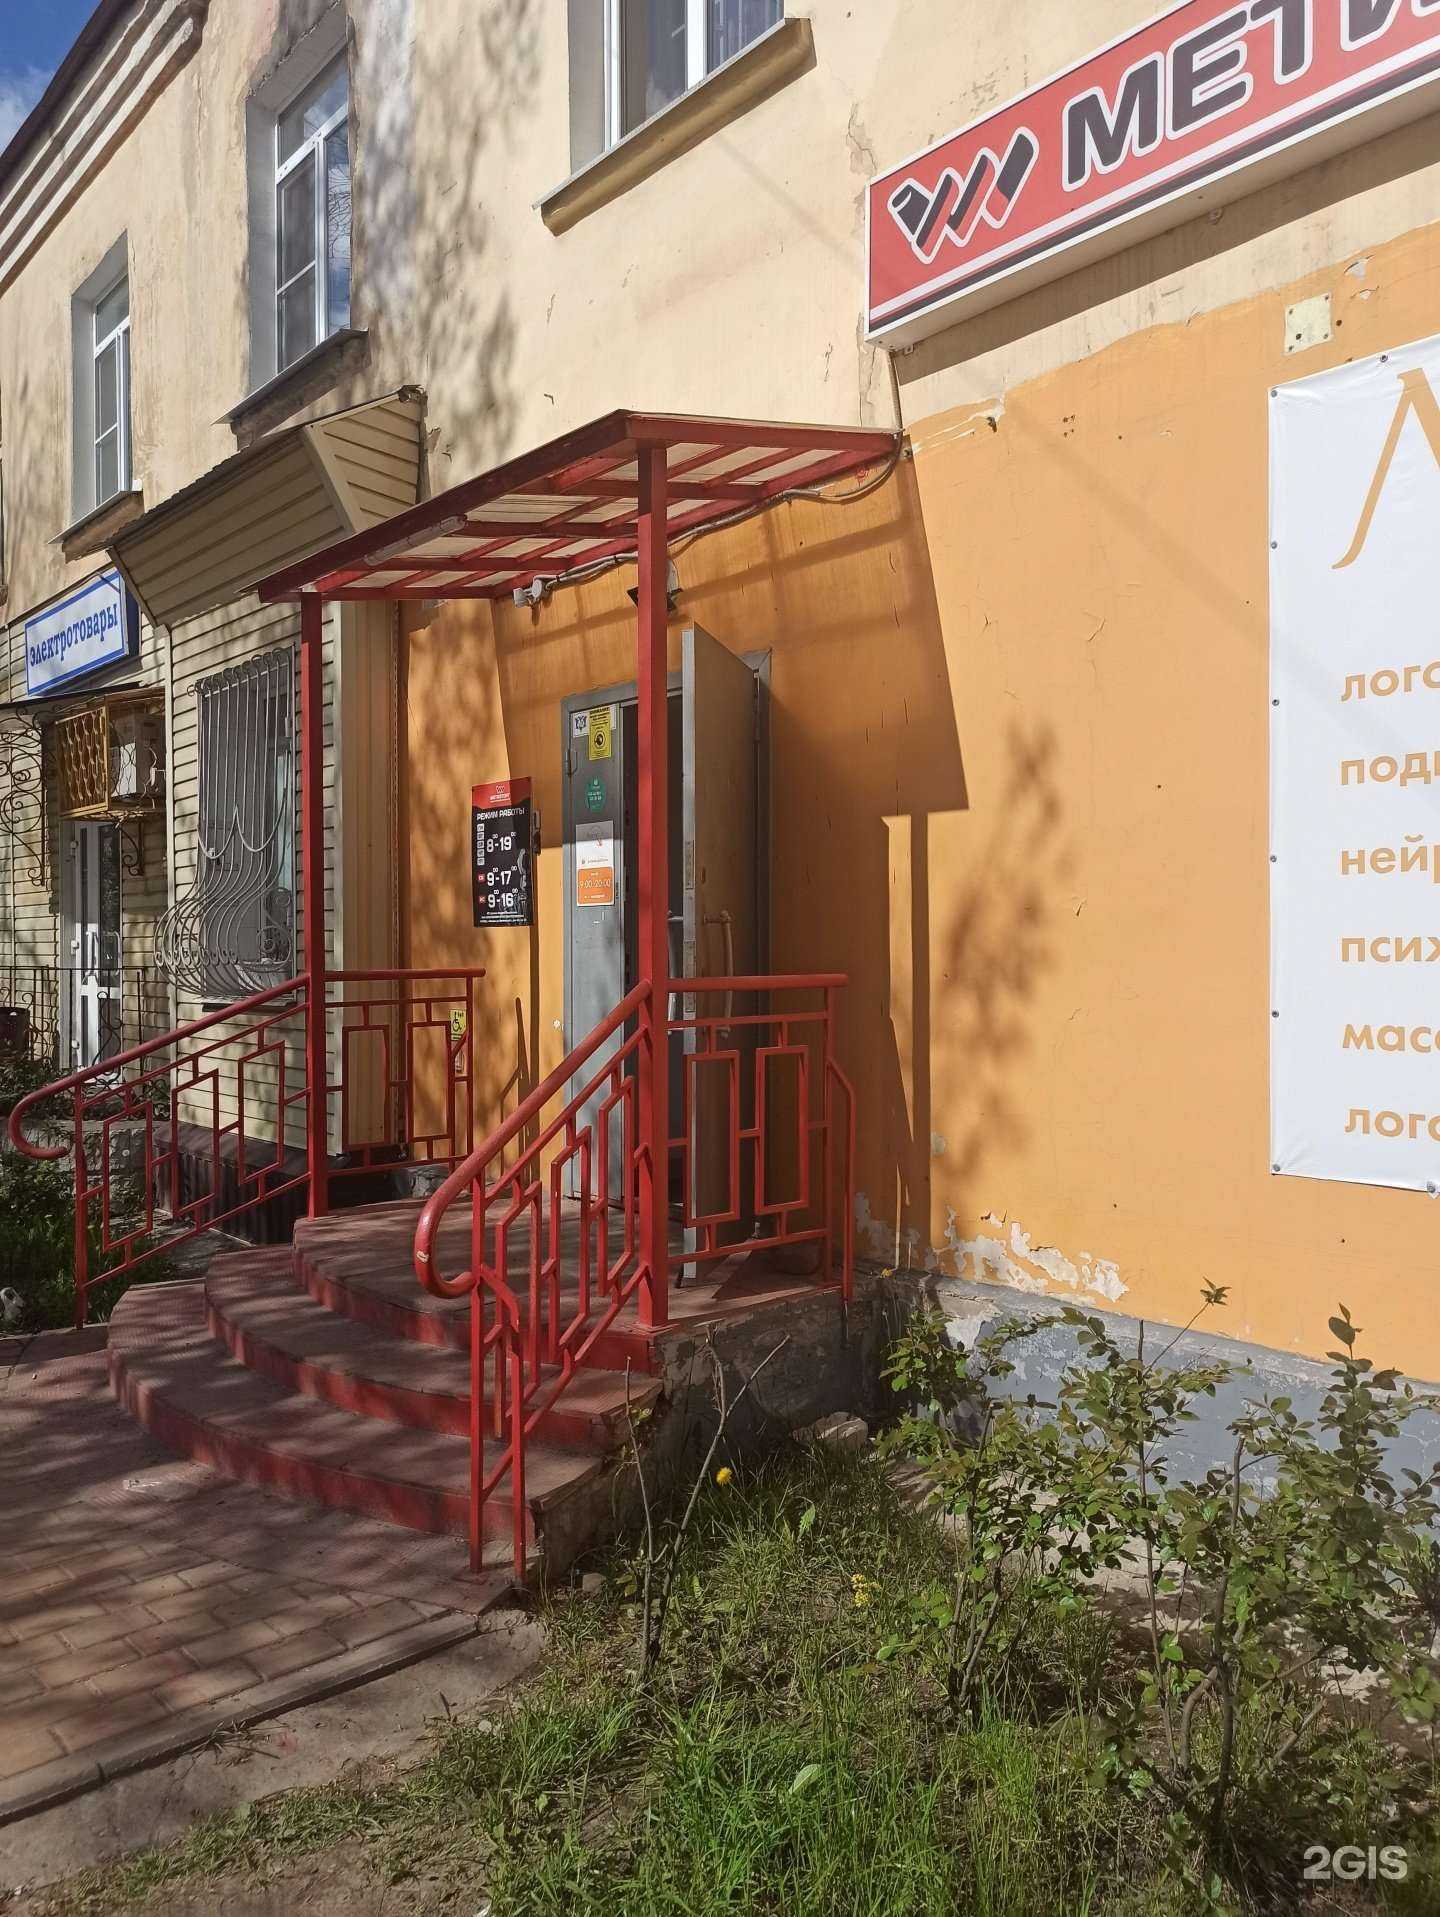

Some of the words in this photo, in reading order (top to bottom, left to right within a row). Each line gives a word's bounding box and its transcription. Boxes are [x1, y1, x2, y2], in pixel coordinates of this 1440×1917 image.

[30, 603, 118, 667] электротовары
[1341, 750, 1440, 787] под
[499, 808, 525, 818] РАБОТЫ
[1341, 834, 1440, 884] ней
[1342, 1024, 1440, 1053] мас
